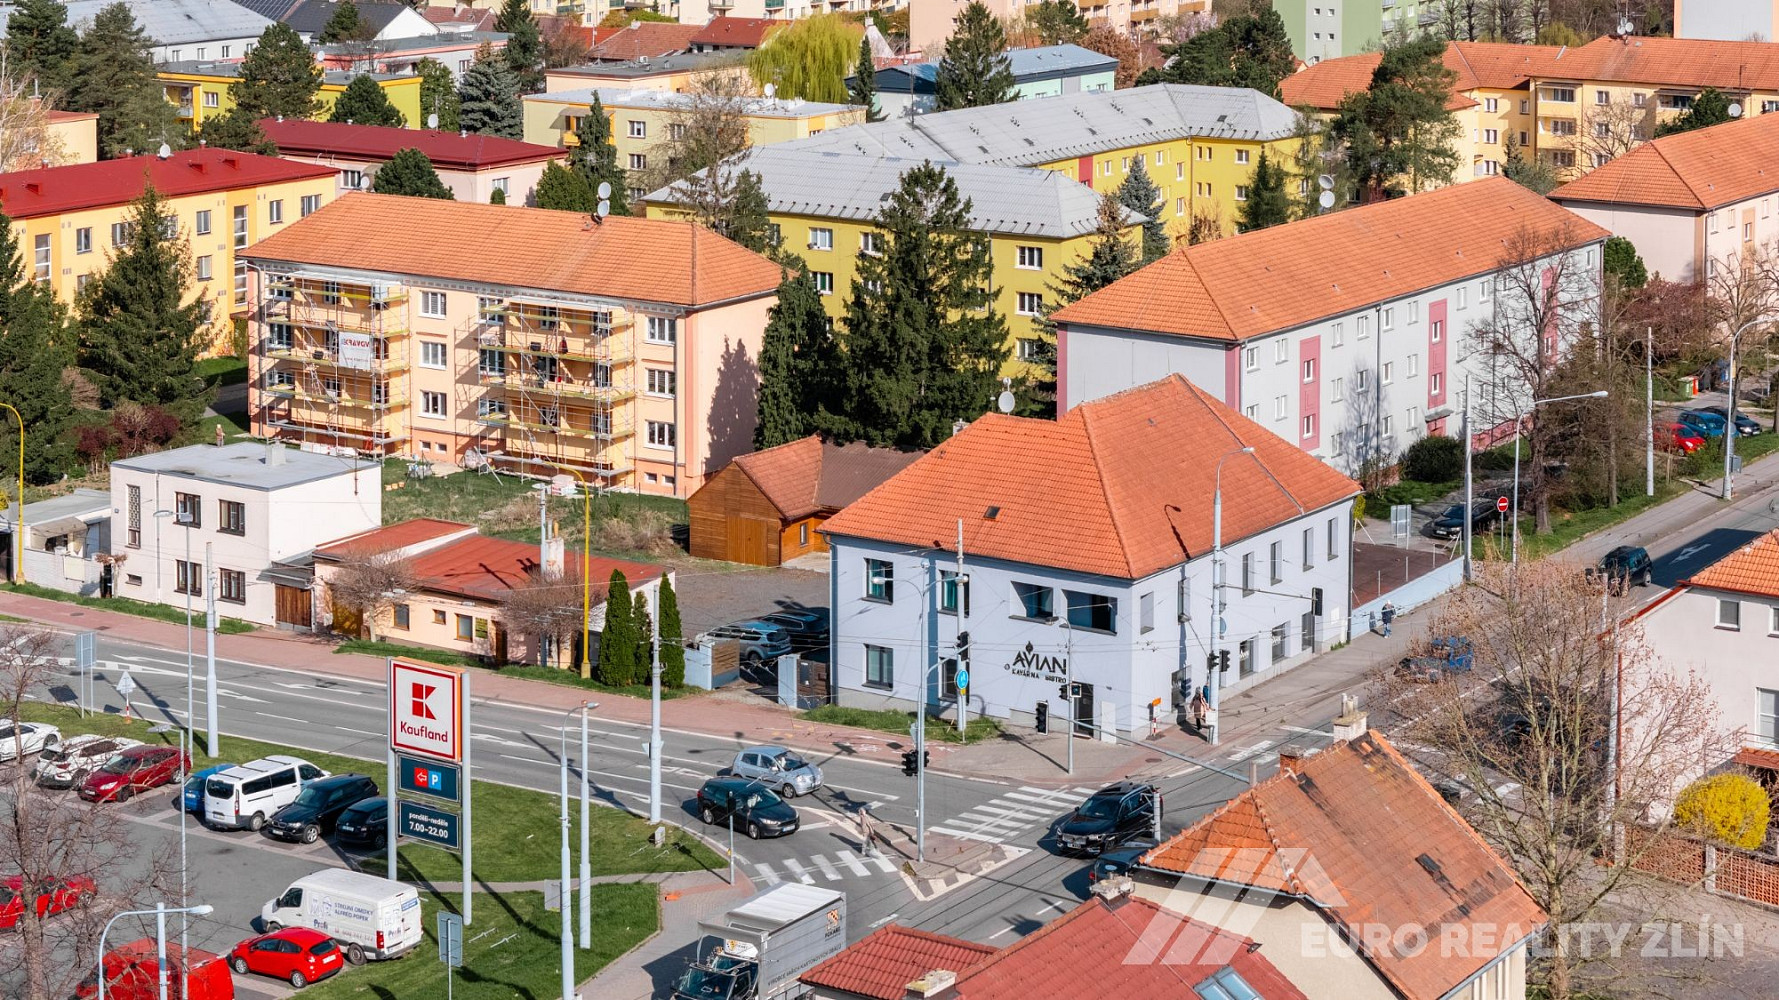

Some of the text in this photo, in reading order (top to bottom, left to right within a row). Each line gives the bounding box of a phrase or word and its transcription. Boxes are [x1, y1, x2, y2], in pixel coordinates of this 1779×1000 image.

[1012, 650, 1067, 676] AVIAN
[1045, 675, 1067, 684] BISTRO
[400, 721, 448, 743] Kaufland
